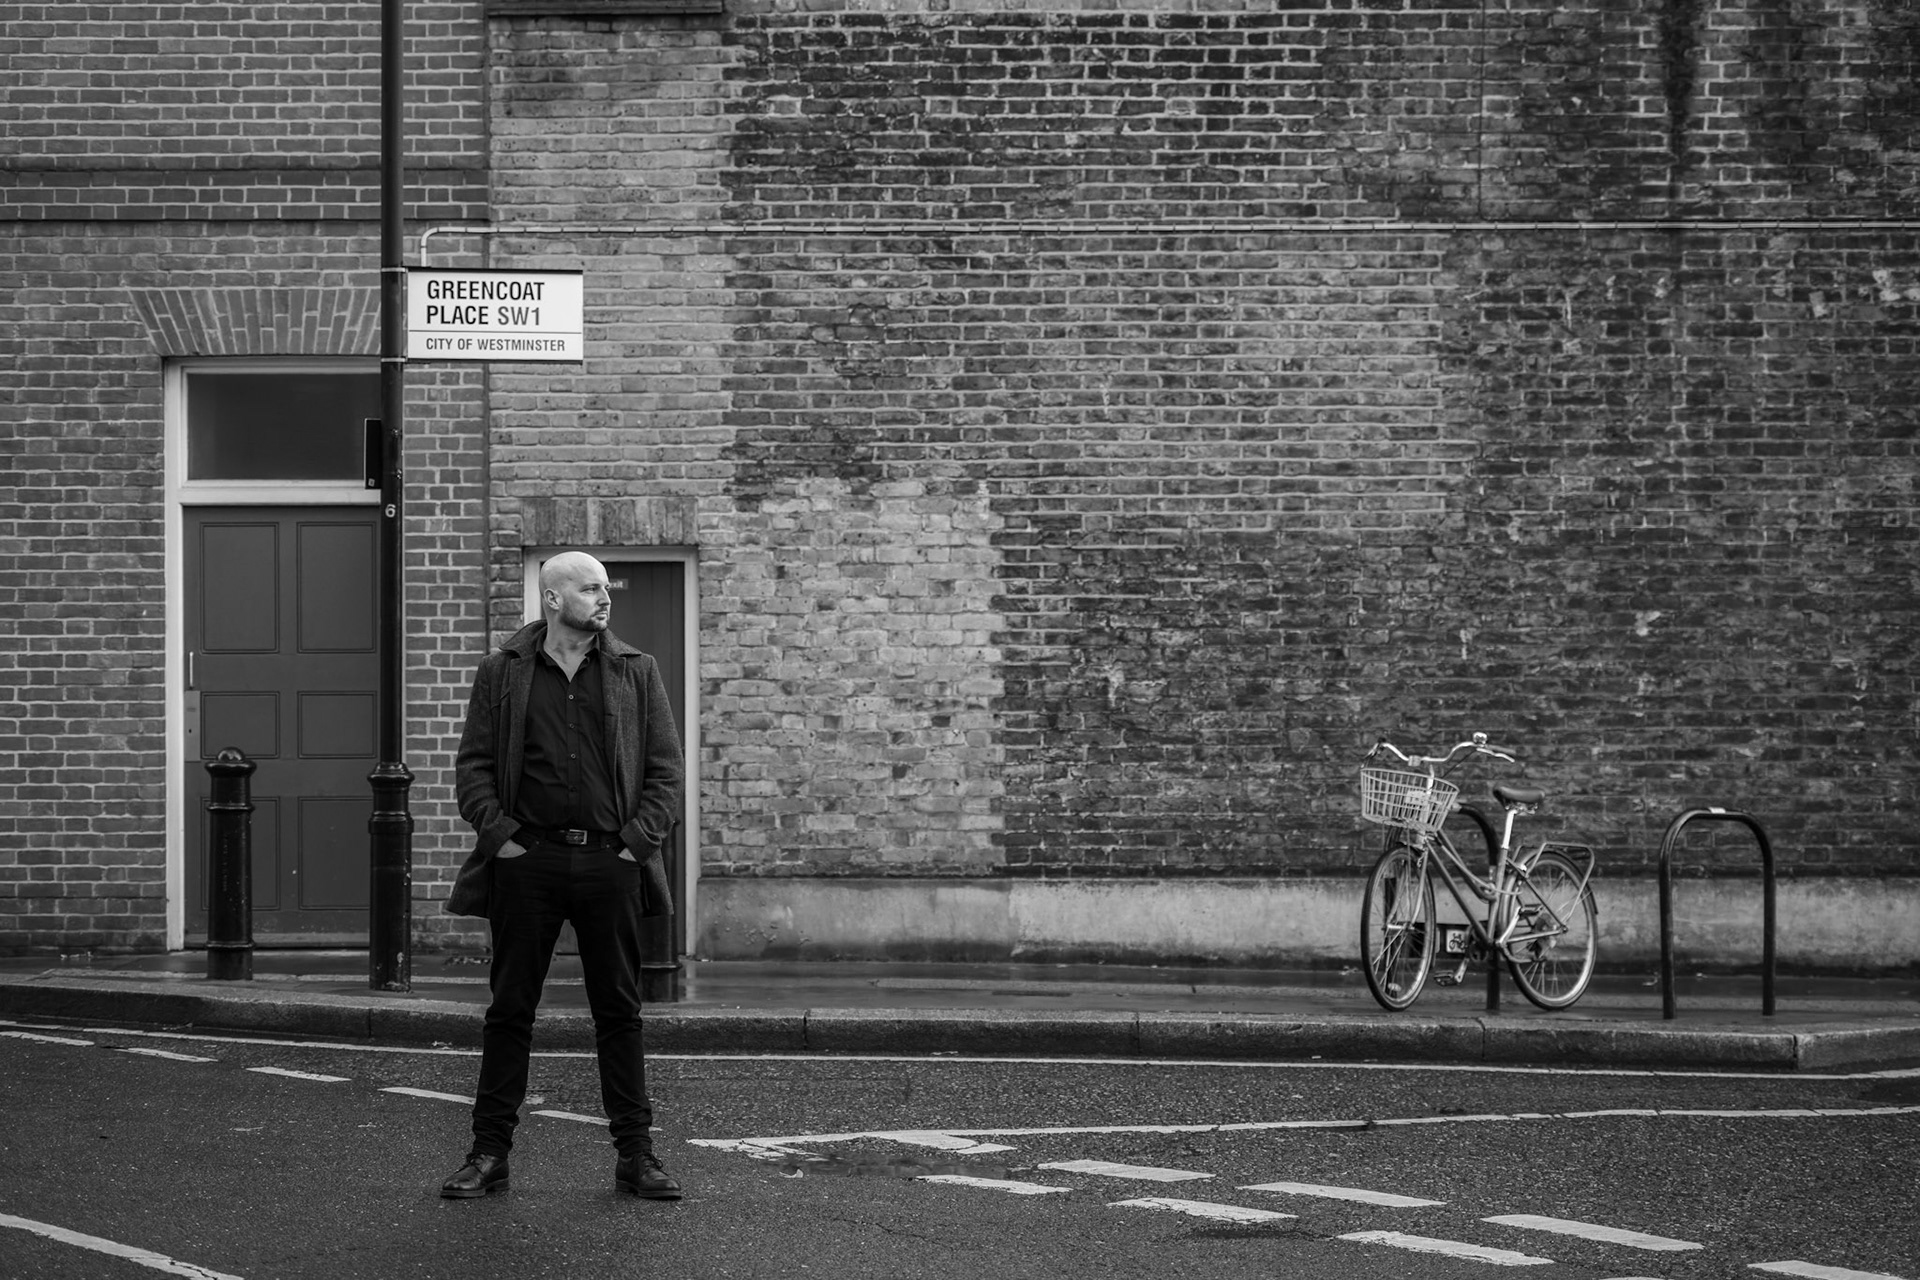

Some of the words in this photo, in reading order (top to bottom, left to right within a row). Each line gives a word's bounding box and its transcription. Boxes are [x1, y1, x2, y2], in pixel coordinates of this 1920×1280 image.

[427, 279, 545, 300] GREENCOAT
[426, 305, 489, 325] PLACE
[497, 306, 540, 326] SW1
[426, 338, 453, 350] CITY
[457, 339, 473, 350] OF
[477, 339, 565, 351] WESTMINSTER
[385, 504, 396, 518] 6
